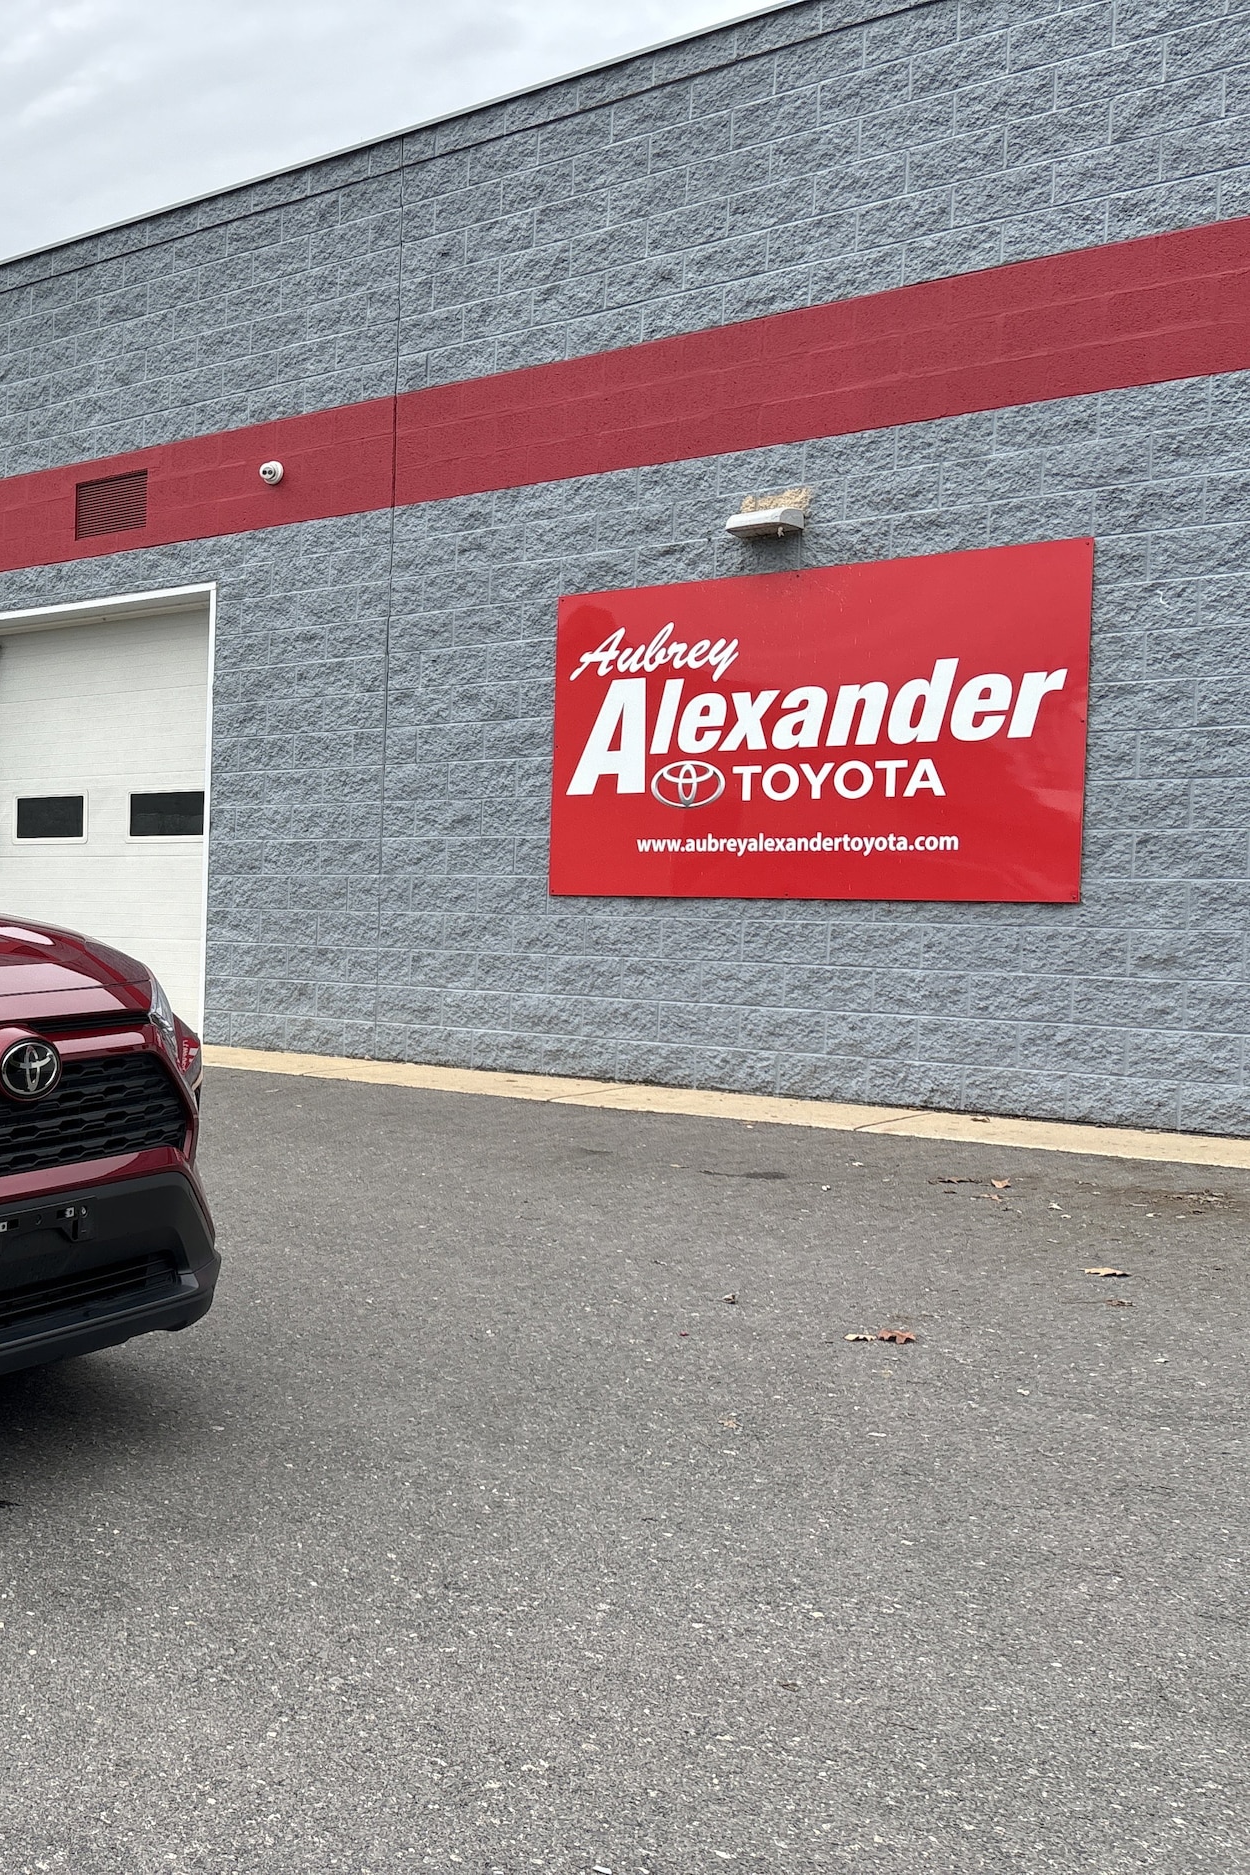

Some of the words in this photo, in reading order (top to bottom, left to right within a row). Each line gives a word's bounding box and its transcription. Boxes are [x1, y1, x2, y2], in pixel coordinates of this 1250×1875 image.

[569, 621, 739, 682] Aubrey
[565, 657, 1068, 796] Alexander
[732, 758, 946, 802] TOYOTA
[636, 832, 959, 857] www.aubreyalexandertoyota.com
